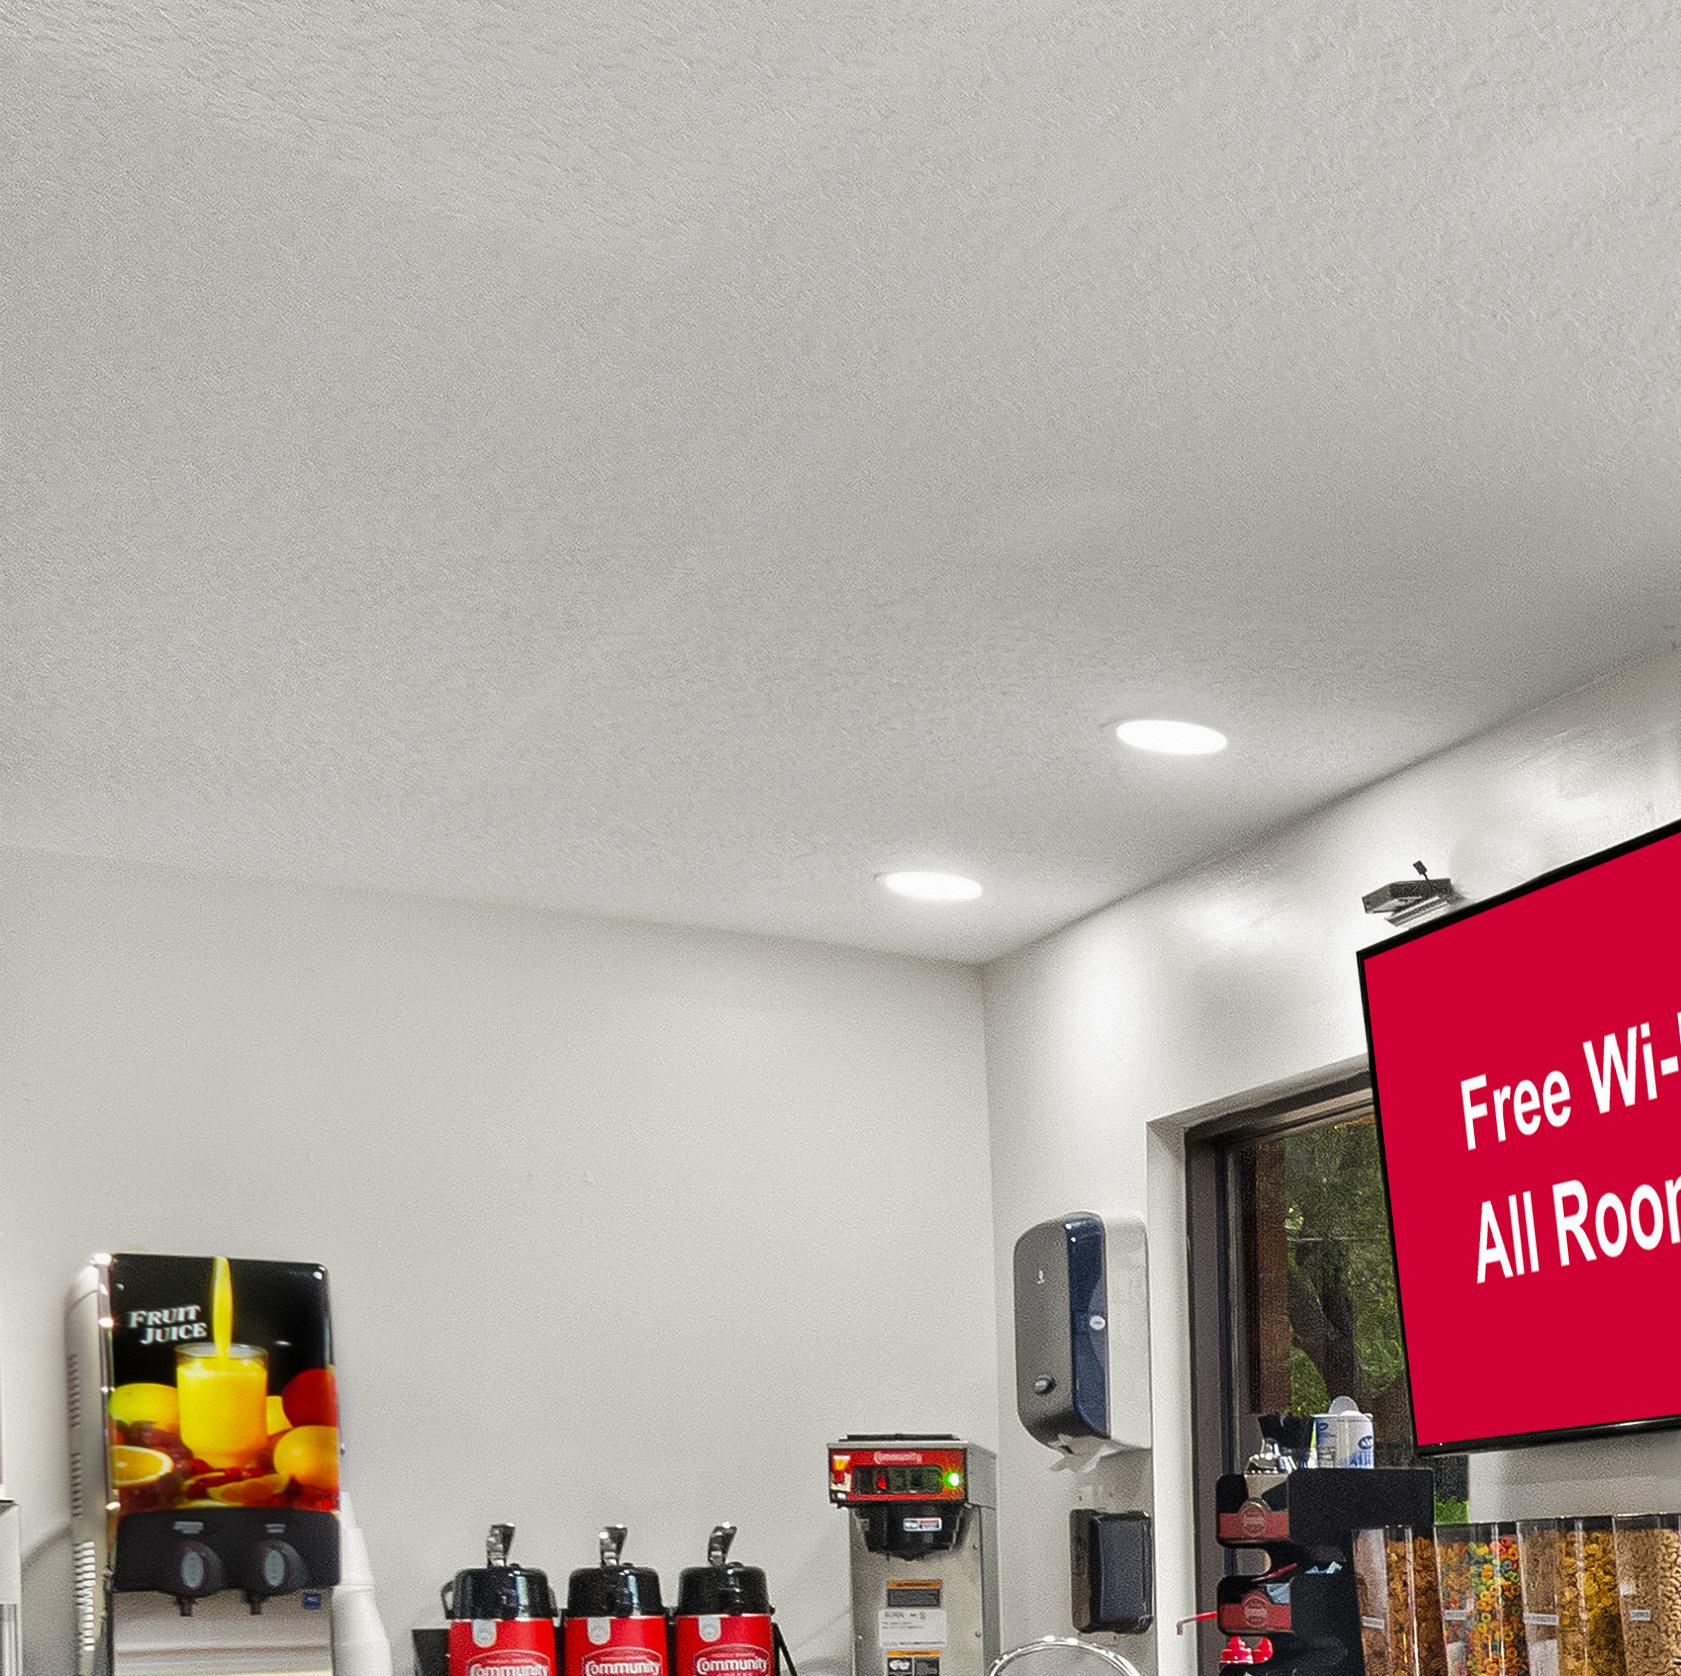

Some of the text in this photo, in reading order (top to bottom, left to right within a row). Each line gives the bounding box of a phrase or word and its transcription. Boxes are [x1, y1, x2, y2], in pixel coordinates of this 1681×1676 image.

[1461, 1074, 1571, 1151] Free
[1477, 1190, 1540, 1284] All
[127, 1304, 202, 1328] FRUIT
[139, 1322, 208, 1344] JUICE
[696, 1656, 768, 1675] Community
